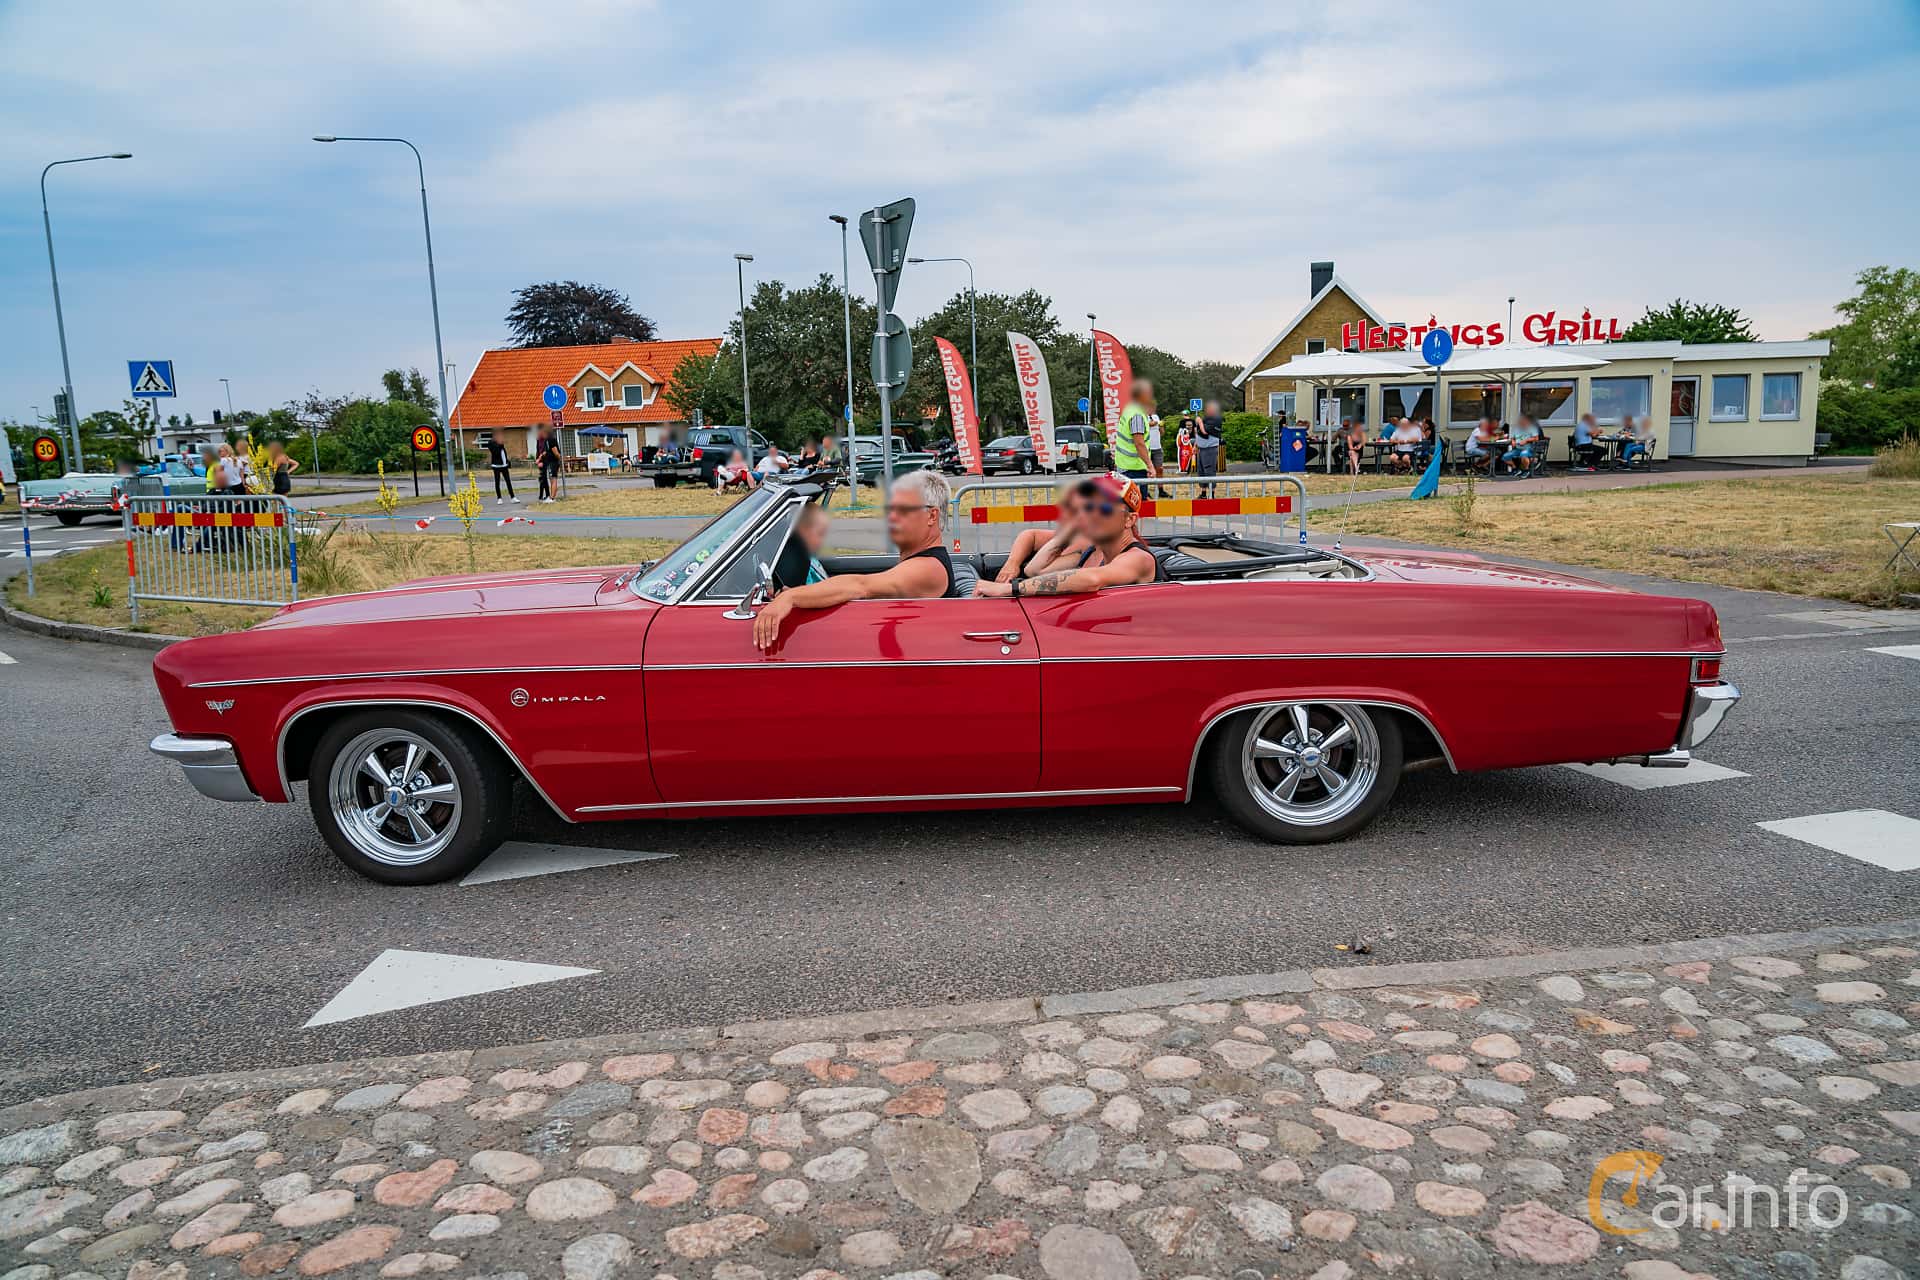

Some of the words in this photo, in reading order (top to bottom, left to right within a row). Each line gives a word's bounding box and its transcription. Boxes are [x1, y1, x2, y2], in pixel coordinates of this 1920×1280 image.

[1523, 307, 1624, 346] GRILL
[417, 433, 433, 445] 30
[39, 444, 54, 456] 30
[533, 695, 607, 703] IMPALA
